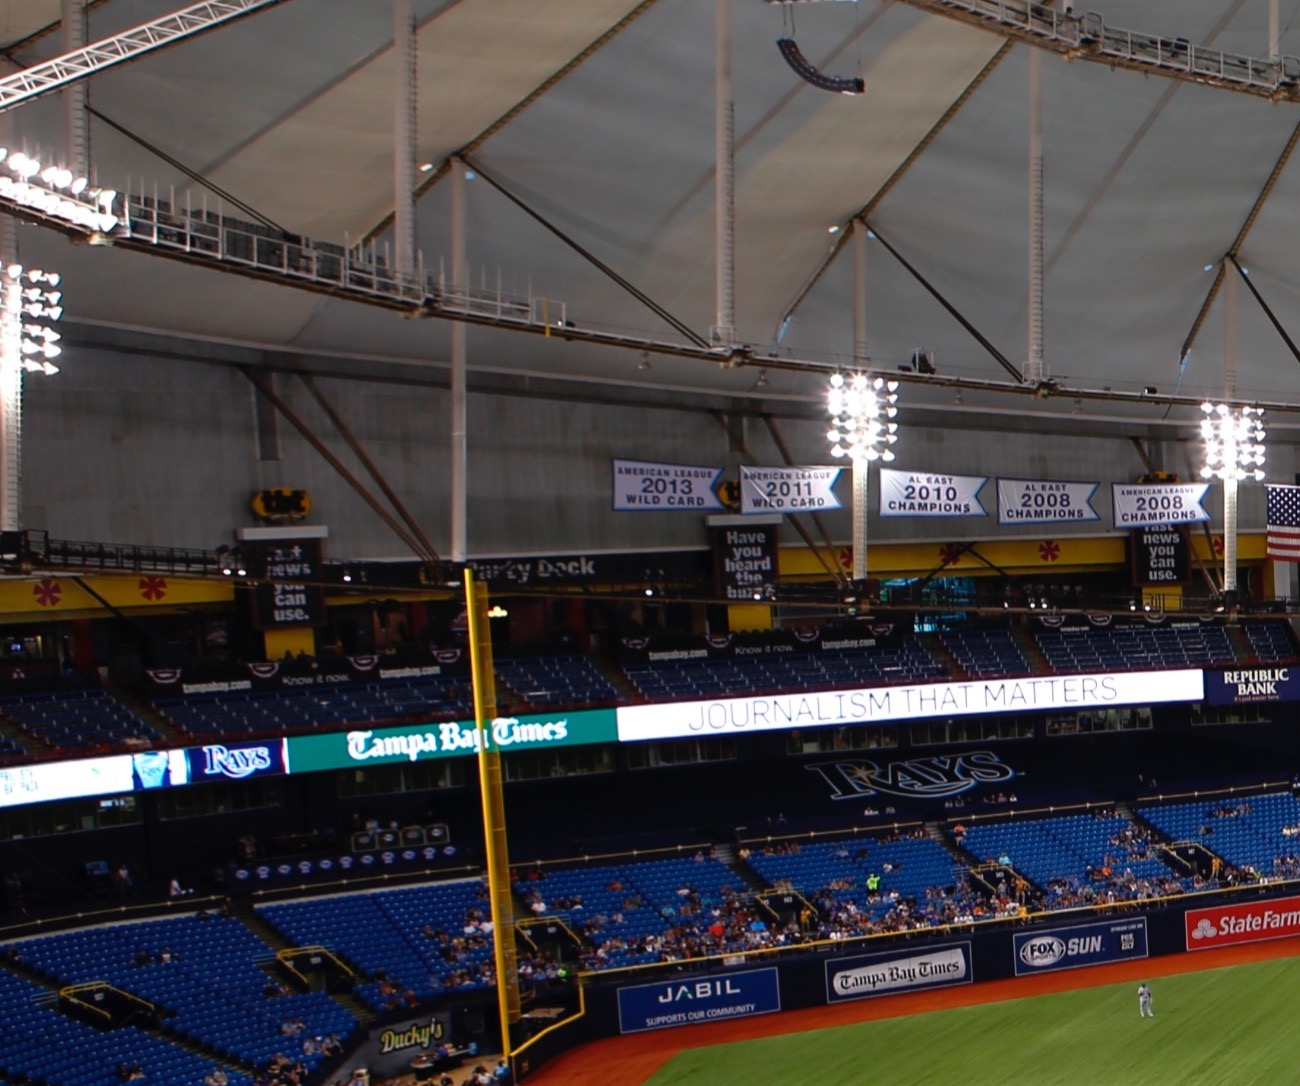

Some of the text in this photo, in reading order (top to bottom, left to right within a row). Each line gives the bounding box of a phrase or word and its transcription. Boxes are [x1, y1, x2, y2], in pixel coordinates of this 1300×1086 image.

[618, 467, 712, 478] AMERICAN LEAGUE
[743, 472, 830, 480] AMERICAN LEAGUE
[642, 478, 693, 494] 2013
[908, 476, 954, 485] AL EAST
[1025, 483, 1066, 491] AL EAST
[766, 482, 813, 496] 2011
[904, 486, 957, 500] 2010
[1121, 488, 1160, 496] AMERICAN
[626, 494, 704, 506] WILD CARD
[752, 497, 825, 508] WILD CARD
[1021, 493, 1071, 507] 2008
[1136, 496, 1183, 510] 2008
[889, 501, 971, 514] CHAMPIONS
[1007, 508, 1084, 519] CHAMPIONS
[1121, 510, 1196, 522] CHAMPIONS
[726, 531, 766, 545] Have
[1143, 532, 1180, 544] news
[732, 546, 762, 560] you
[1149, 545, 1175, 559] you
[725, 559, 771, 571] heard
[1150, 559, 1175, 568] can
[1149, 570, 1177, 581] use.
[275, 592, 306, 607] can
[274, 609, 310, 622] use.
[649, 639, 876, 660] tampabay.com Know it now. tampabay.com
[1224, 668, 1290, 685] REPUBLIC
[1237, 681, 1278, 696] BANK
[688, 676, 1119, 732] JOURNALISM THAT MATTERS
[346, 728, 436, 762] Tampa
[492, 718, 568, 744] Times
[202, 744, 271, 778] RAYS
[1219, 913, 1262, 936] State
[1030, 935, 1102, 956] FOX SUN
[839, 958, 960, 991] Tampa Bay Times
[658, 979, 741, 1003] JABIL
[646, 1002, 756, 1028] SUPPORTS OUR COMMUNITY
[380, 1016, 443, 1054] Ducky's
